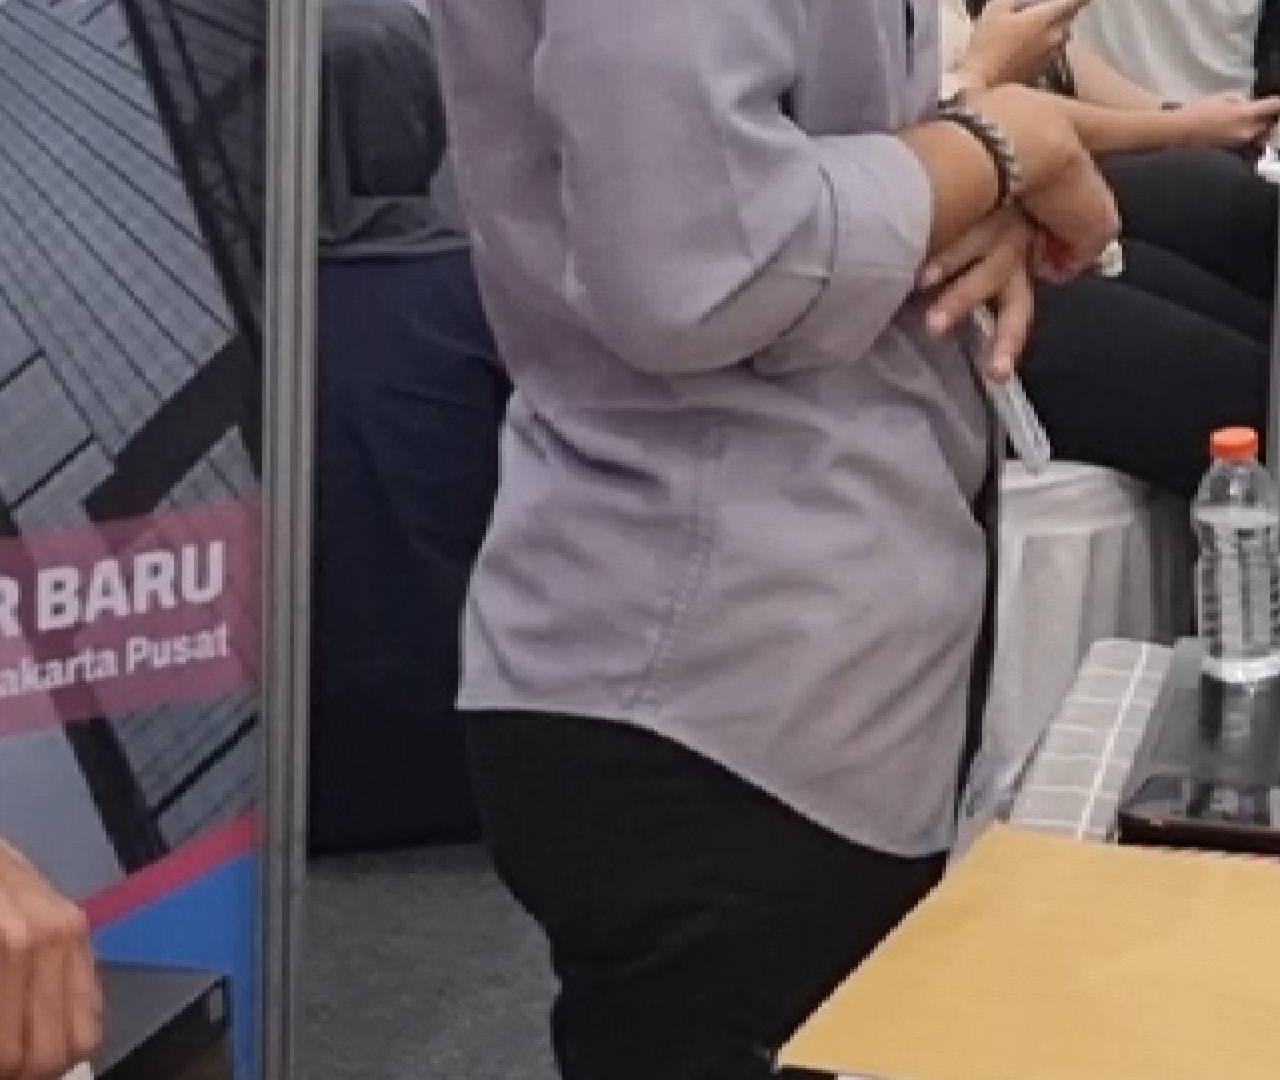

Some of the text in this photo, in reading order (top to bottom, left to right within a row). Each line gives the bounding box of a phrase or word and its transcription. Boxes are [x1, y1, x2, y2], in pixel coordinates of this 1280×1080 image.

[36, 540, 225, 632] BARU
[0, 622, 228, 699] akarta Pusat
